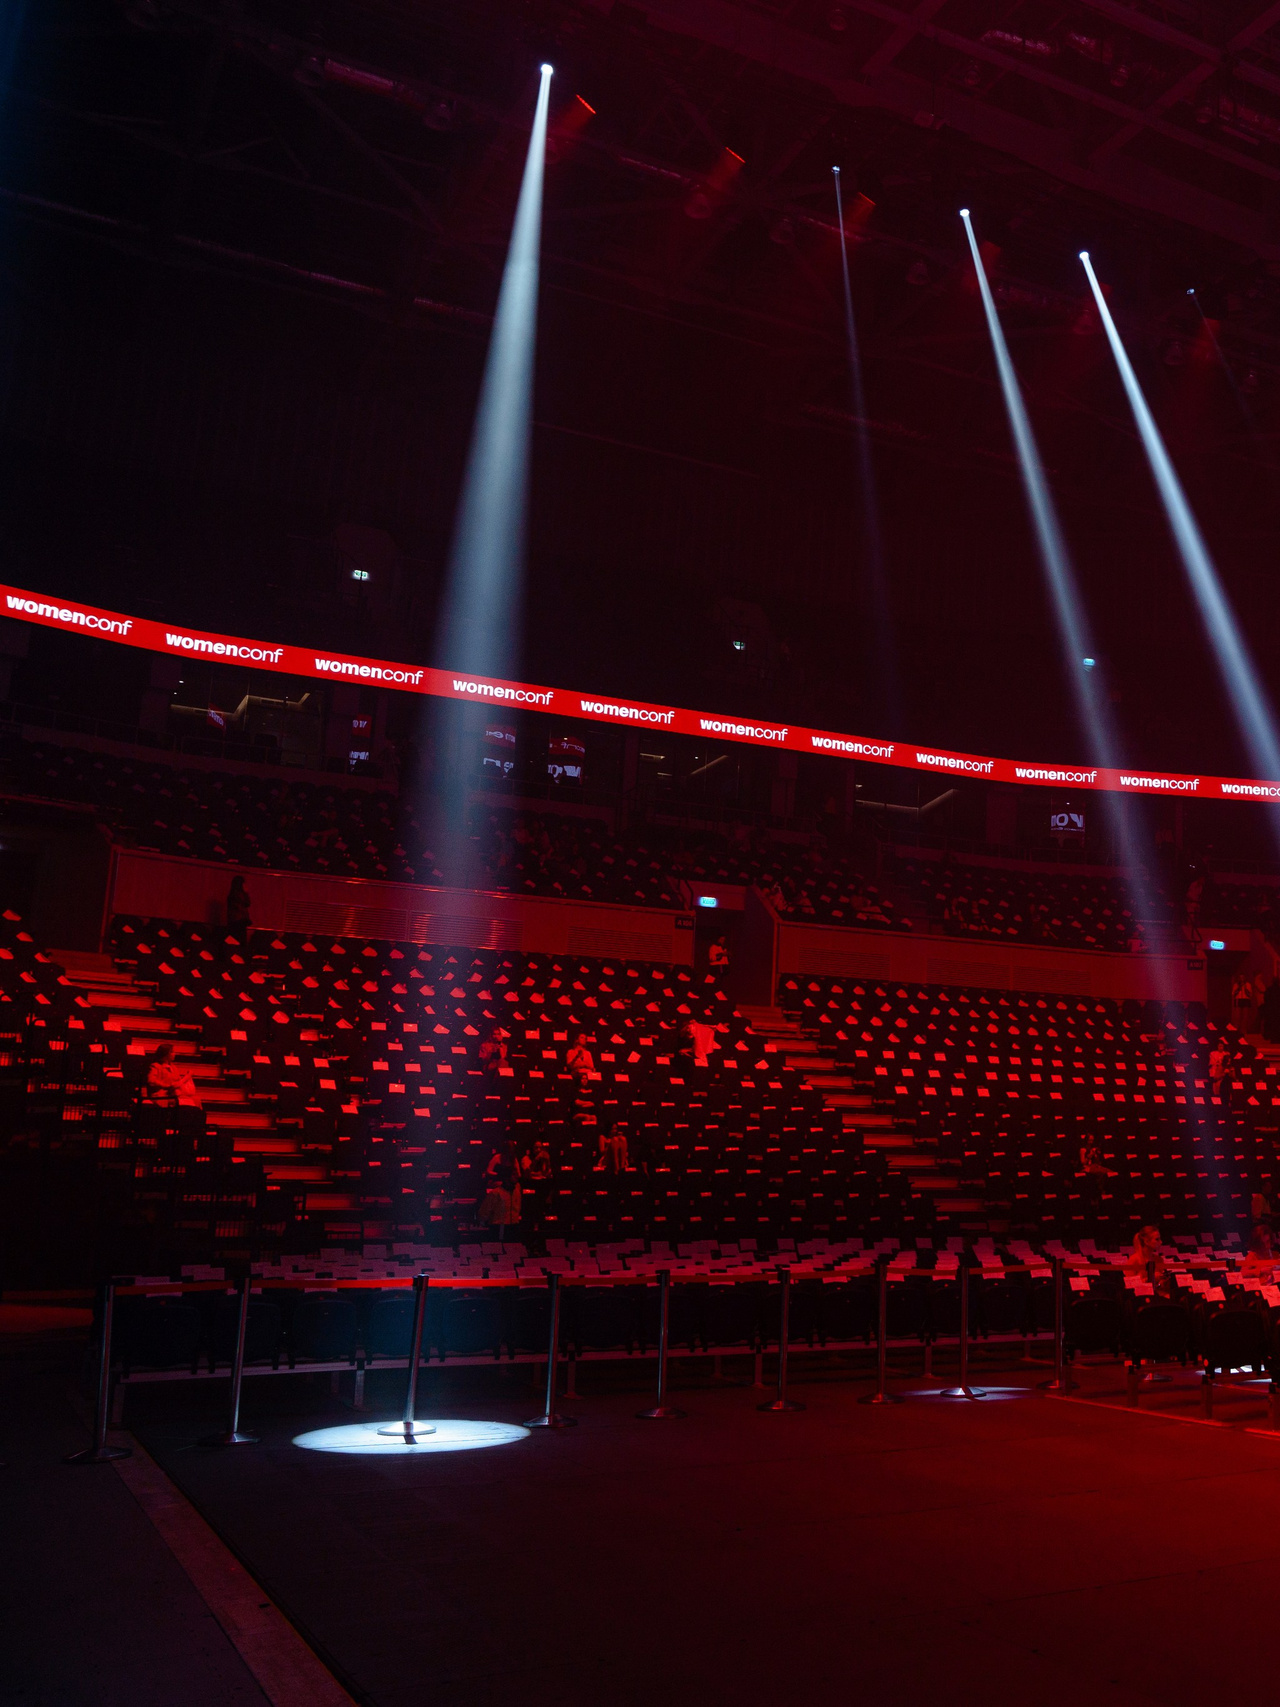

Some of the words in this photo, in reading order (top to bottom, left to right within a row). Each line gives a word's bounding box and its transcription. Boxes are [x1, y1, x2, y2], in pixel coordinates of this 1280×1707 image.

[6, 594, 134, 635] womenconf
[165, 632, 284, 663] womenconf
[314, 657, 424, 685] womenconf
[452, 679, 554, 706] womenconf
[580, 699, 675, 725] womenconf
[699, 718, 789, 742] womenconf
[811, 734, 895, 758] womenconf
[915, 751, 995, 774] womenconf
[1015, 766, 1098, 784] womenconf
[1119, 775, 1200, 792] womenconf
